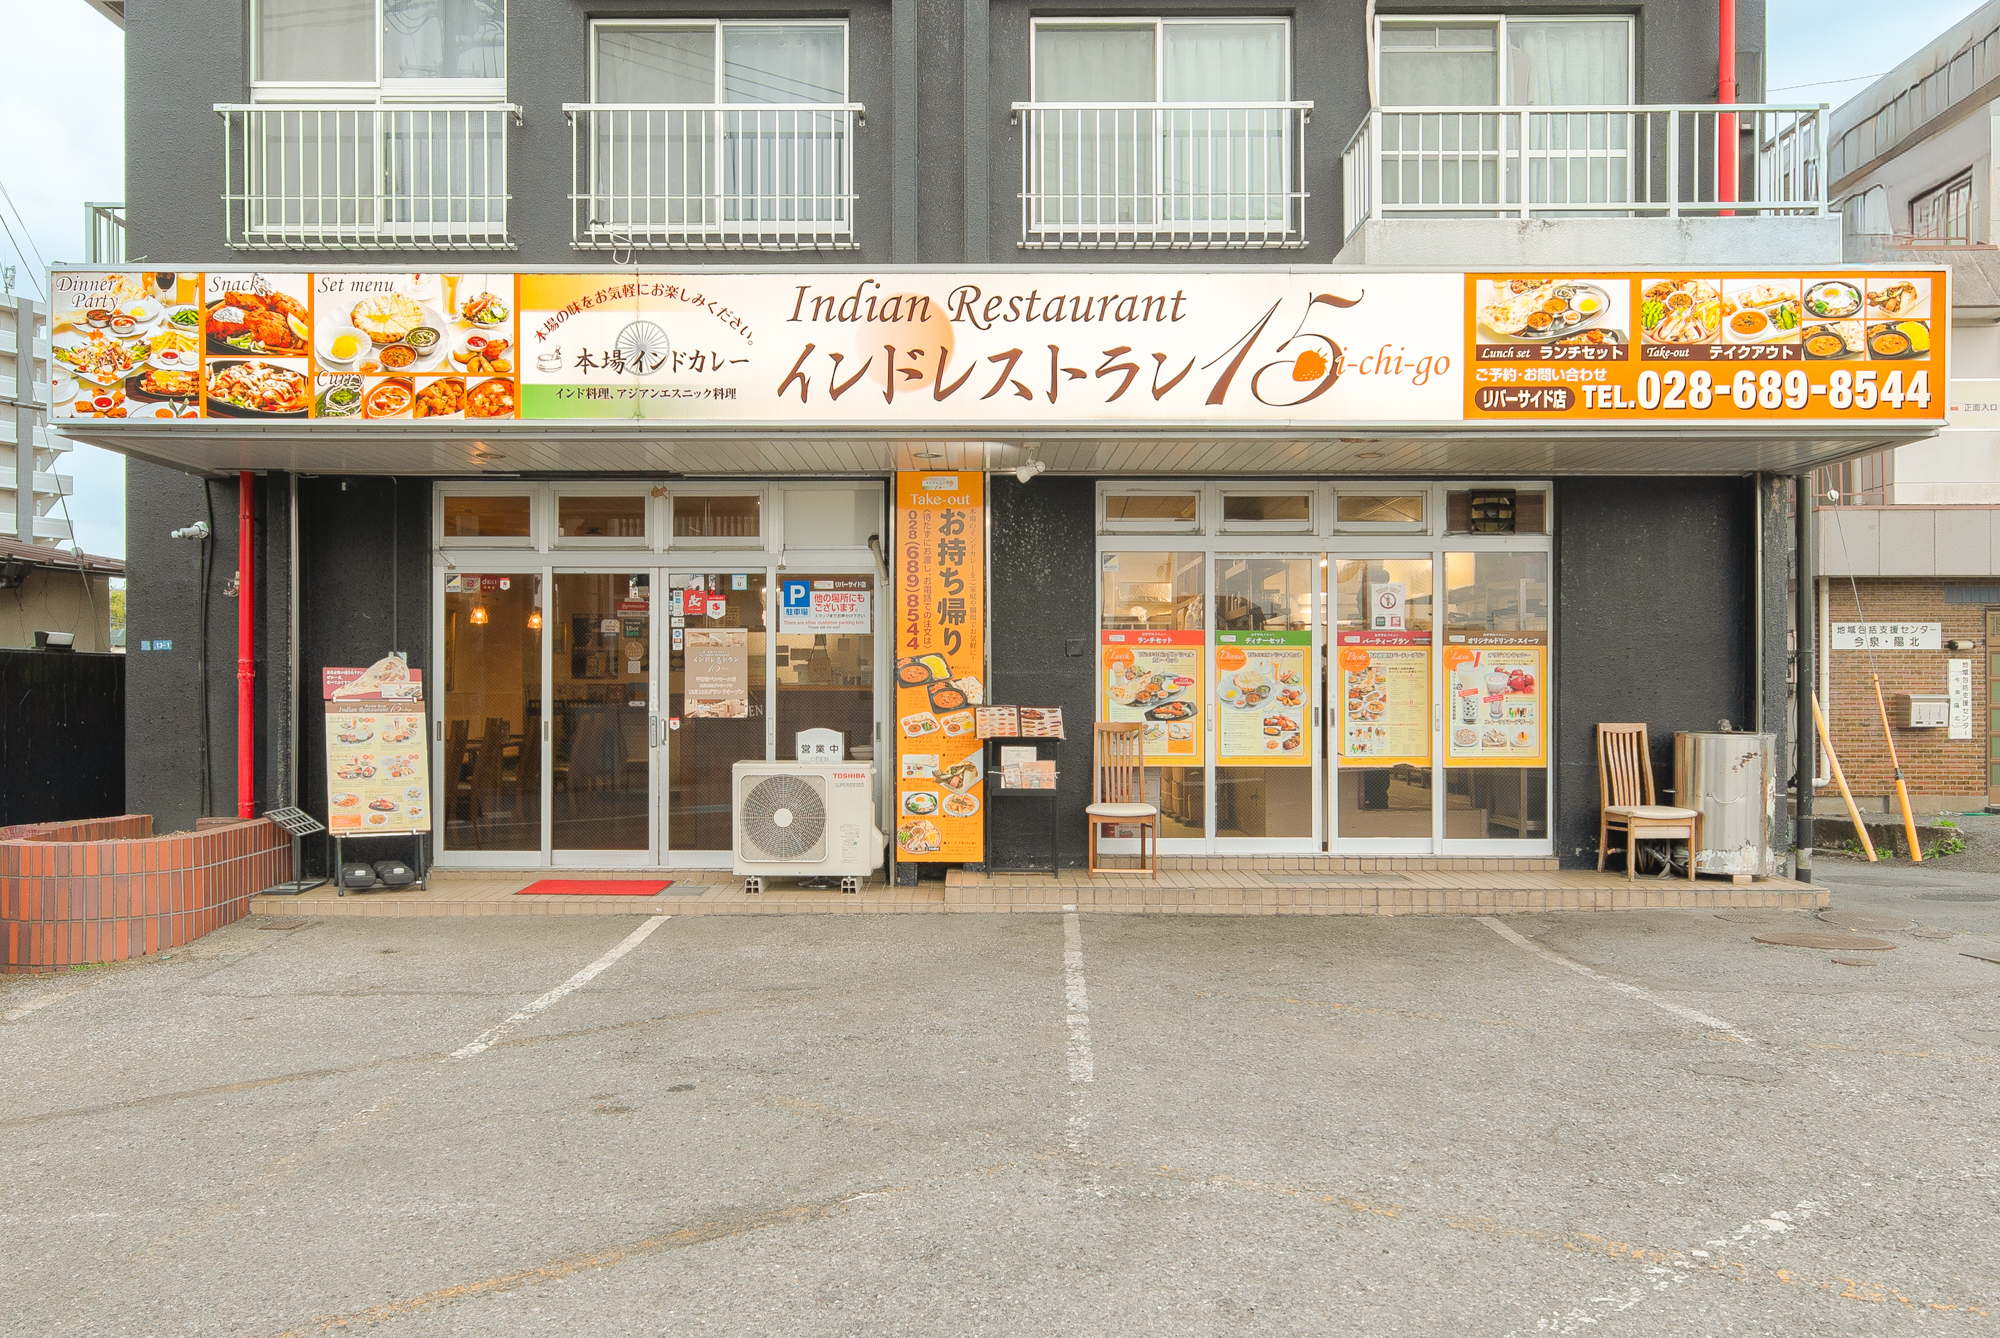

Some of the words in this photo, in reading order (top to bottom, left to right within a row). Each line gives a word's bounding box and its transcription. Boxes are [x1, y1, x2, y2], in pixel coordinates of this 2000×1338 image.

[55, 274, 118, 293] Dinner
[208, 275, 261, 294] Snack
[317, 276, 345, 293] Set
[349, 280, 396, 293] menu
[72, 292, 118, 312] Party
[787, 278, 932, 323] Indian
[947, 284, 1187, 331] Restaurant
[533, 282, 754, 346] 本場の味をお気軽にお楽しみください。
[1201, 288, 1365, 406] 15
[1481, 347, 1514, 359] Lunch
[1516, 349, 1531, 359] set
[1539, 345, 1625, 360] ランチセット
[1646, 347, 1690, 359] Take-out
[1709, 345, 1795, 360] テイクアウト
[573, 347, 750, 375] 本場インドカレー
[1336, 343, 1451, 384] i-chi-go
[316, 369, 366, 392] Curry
[778, 343, 1197, 404] インドレストラン
[1475, 368, 1607, 382] ご予約・お問い合わせ
[555, 387, 737, 400] インド料理、アジアンエスニック料理
[1482, 390, 1567, 410] リバーサイド店
[1964, 403, 1998, 412] 正面入口
[910, 492, 970, 505] Take-out
[937, 508, 967, 656] お持ち帰り
[790, 584, 806, 605] P
[814, 593, 865, 603] 他の場所にも
[785, 608, 809, 616] 駐車場
[814, 603, 859, 612] ございます。
[1836, 625, 1938, 635] 地域包括支援センター
[1467, 637, 1540, 645] オリジナルドリンク・スイーツ
[1854, 636, 1920, 648] 今泉・陽北
[1110, 650, 1130, 660] Lunch
[1219, 651, 1246, 660] Dinner
[1347, 652, 1367, 666] Party
[801, 744, 839, 754] 営業中
